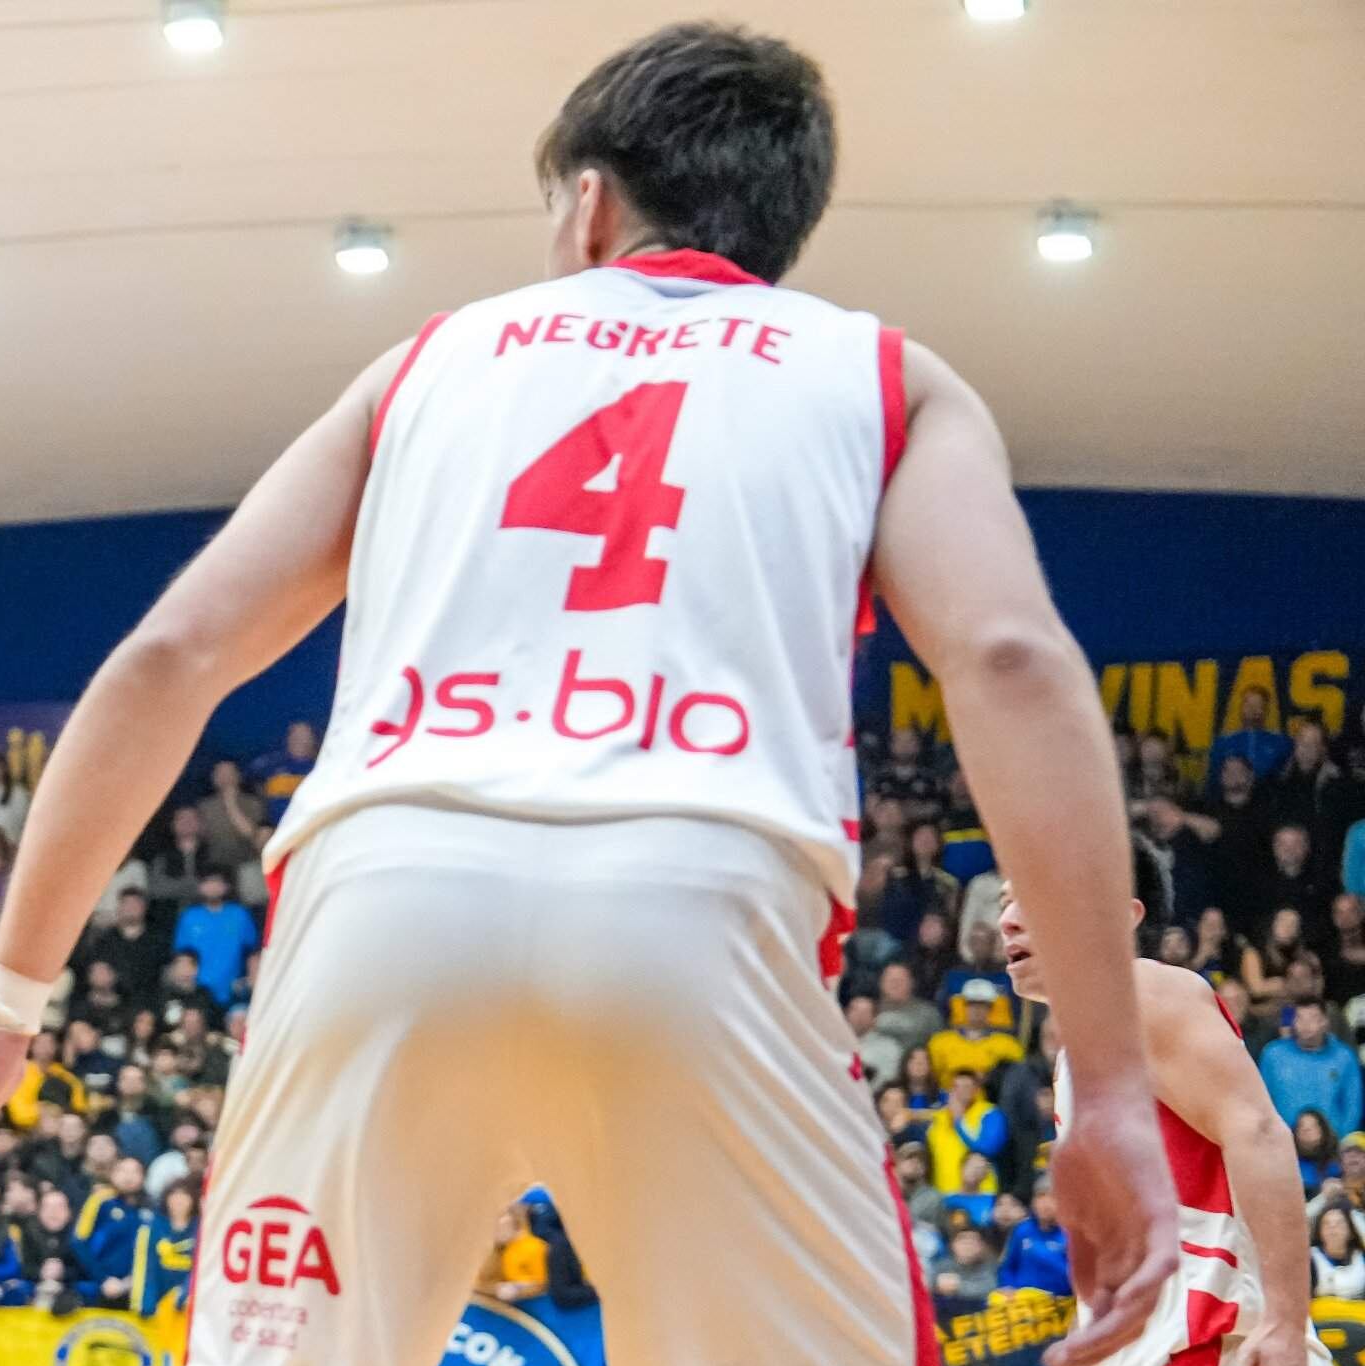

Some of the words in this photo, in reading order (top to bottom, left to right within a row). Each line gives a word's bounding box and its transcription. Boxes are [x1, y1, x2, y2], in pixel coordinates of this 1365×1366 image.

[494, 312, 794, 367] NEGRETE
[498, 380, 690, 612] 4
[890, 649, 1350, 748] MVINAS
[222, 1218, 342, 1296] GEA
